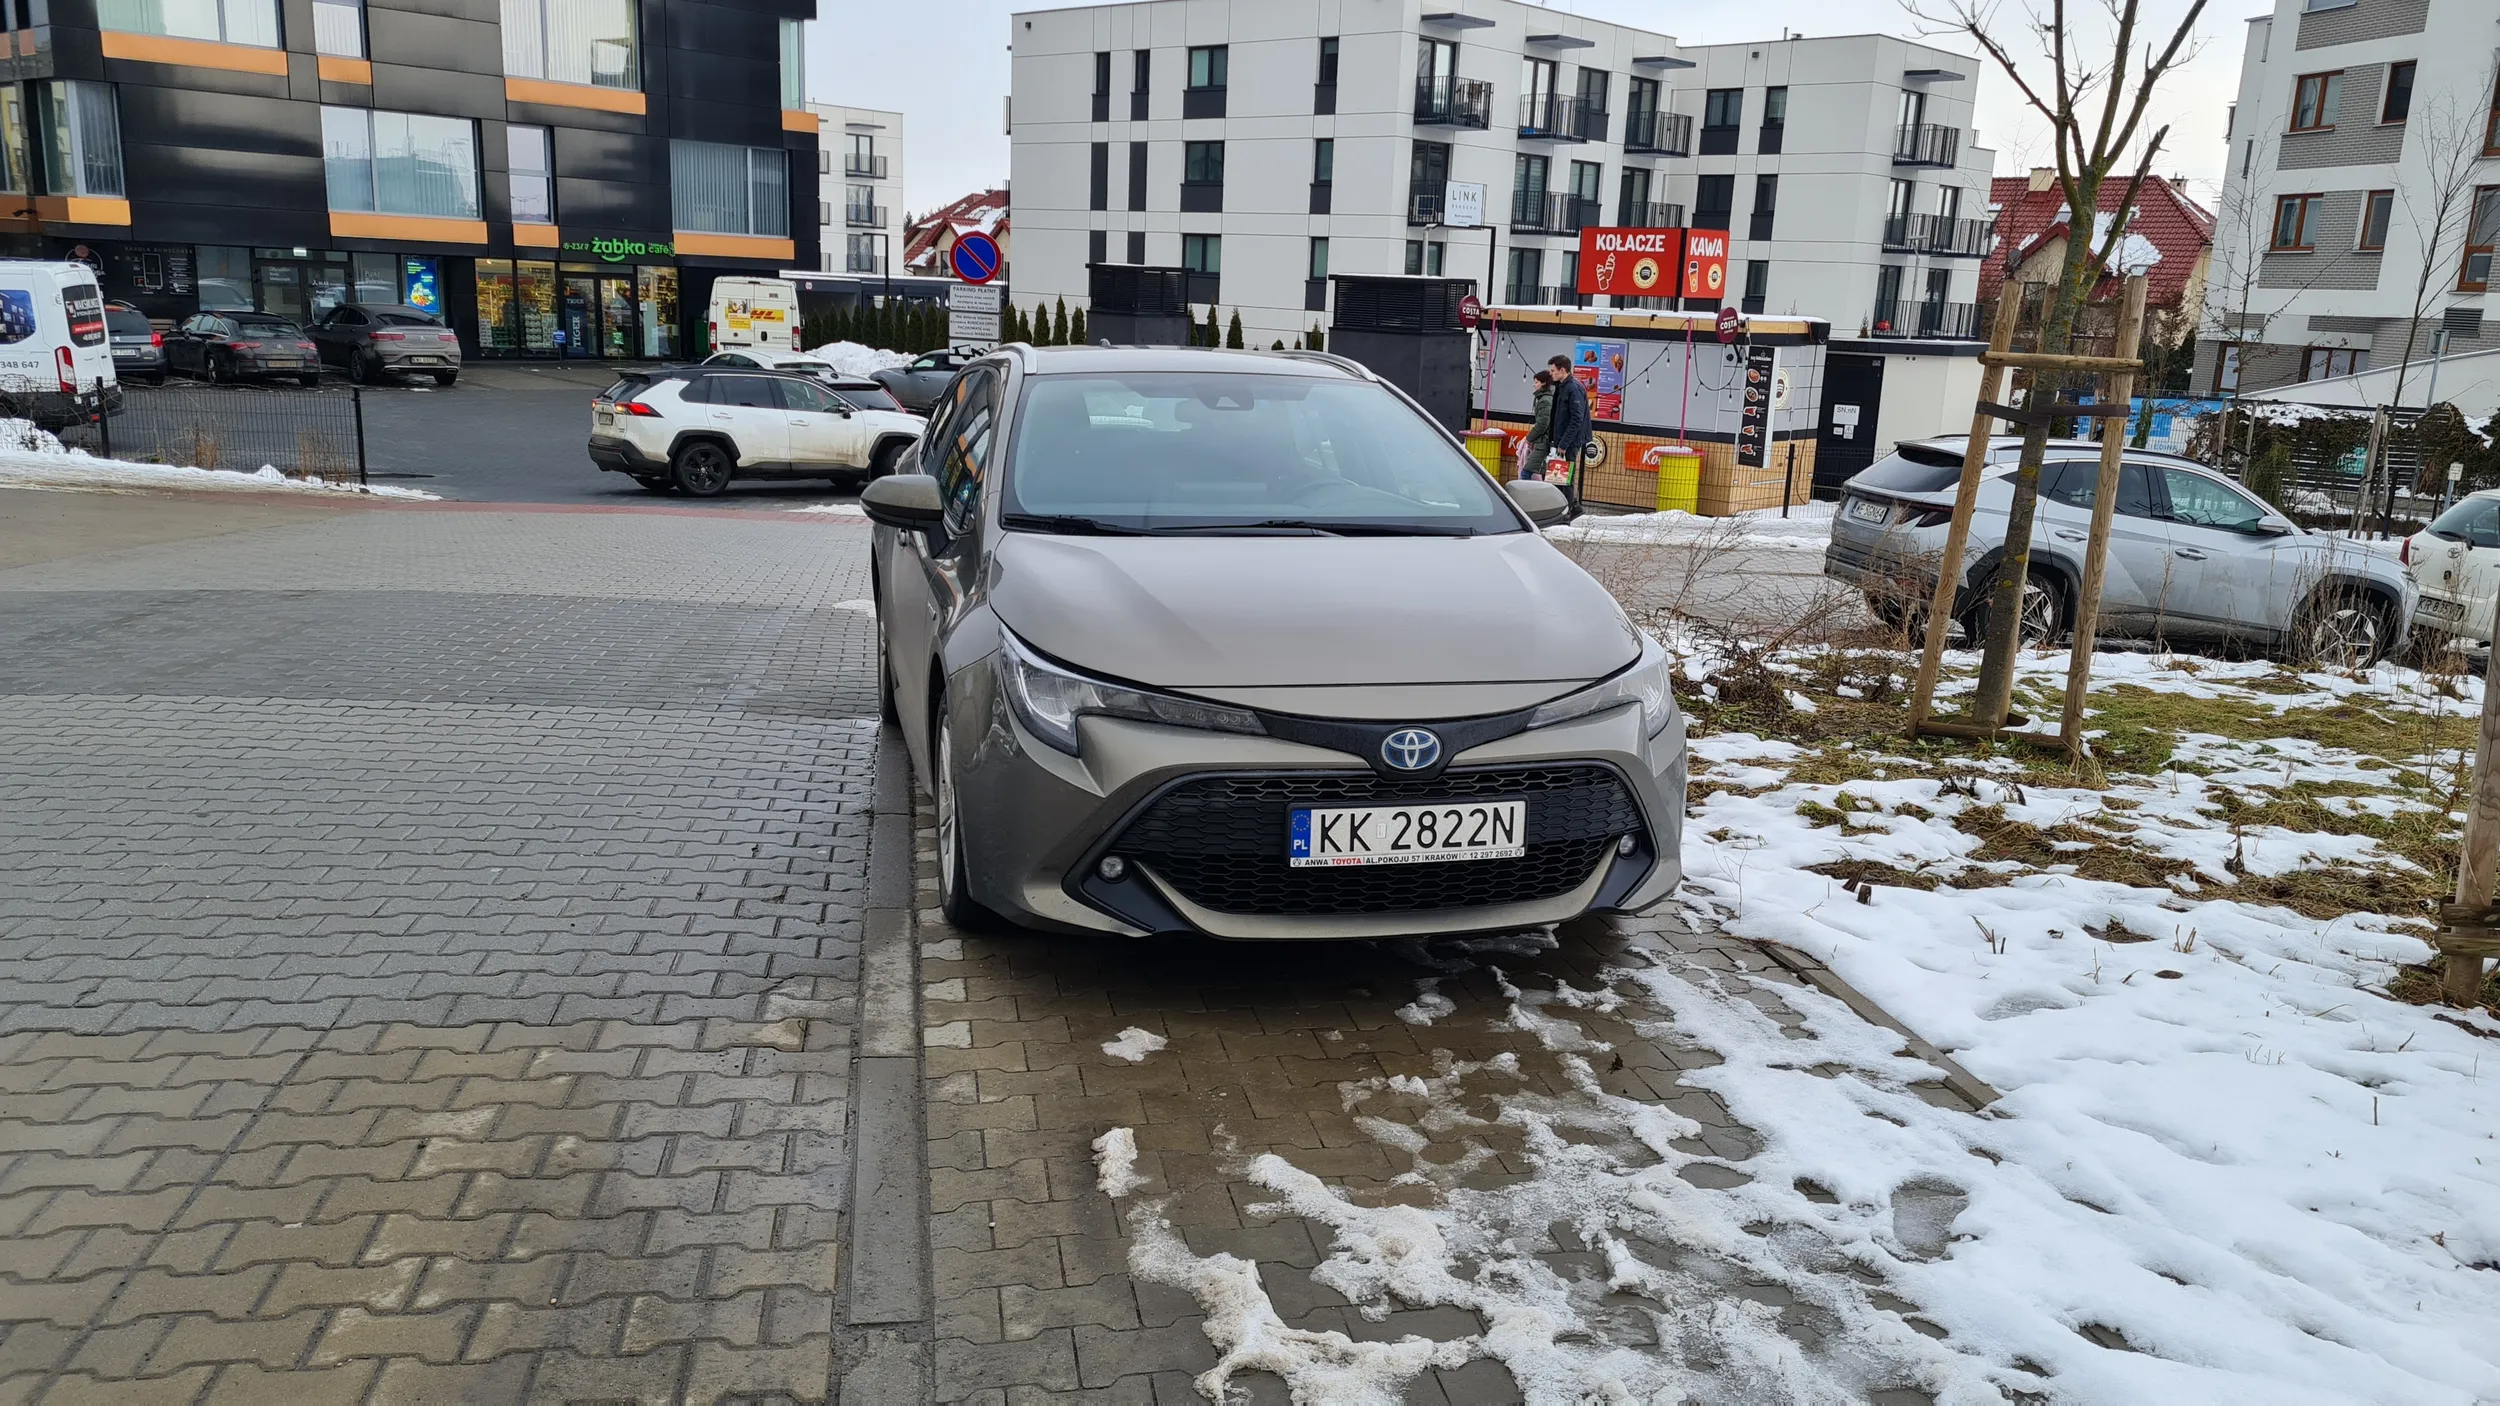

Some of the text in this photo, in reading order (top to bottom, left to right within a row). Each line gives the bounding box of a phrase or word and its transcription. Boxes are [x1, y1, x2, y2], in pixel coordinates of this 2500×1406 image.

[1452, 189, 1477, 203] LINK
[592, 236, 646, 256] żabka
[1596, 233, 1666, 252] KOŁACZE
[1690, 236, 1723, 258] KAWA
[1462, 306, 1480, 316] COSTA
[572, 316, 582, 348] TIGER
[1720, 319, 1738, 330] COSTA
[0, 360, 39, 369] 348 647
[1293, 806, 1515, 854] PL KK 2822N
[1495, 849, 1513, 858] 2692
